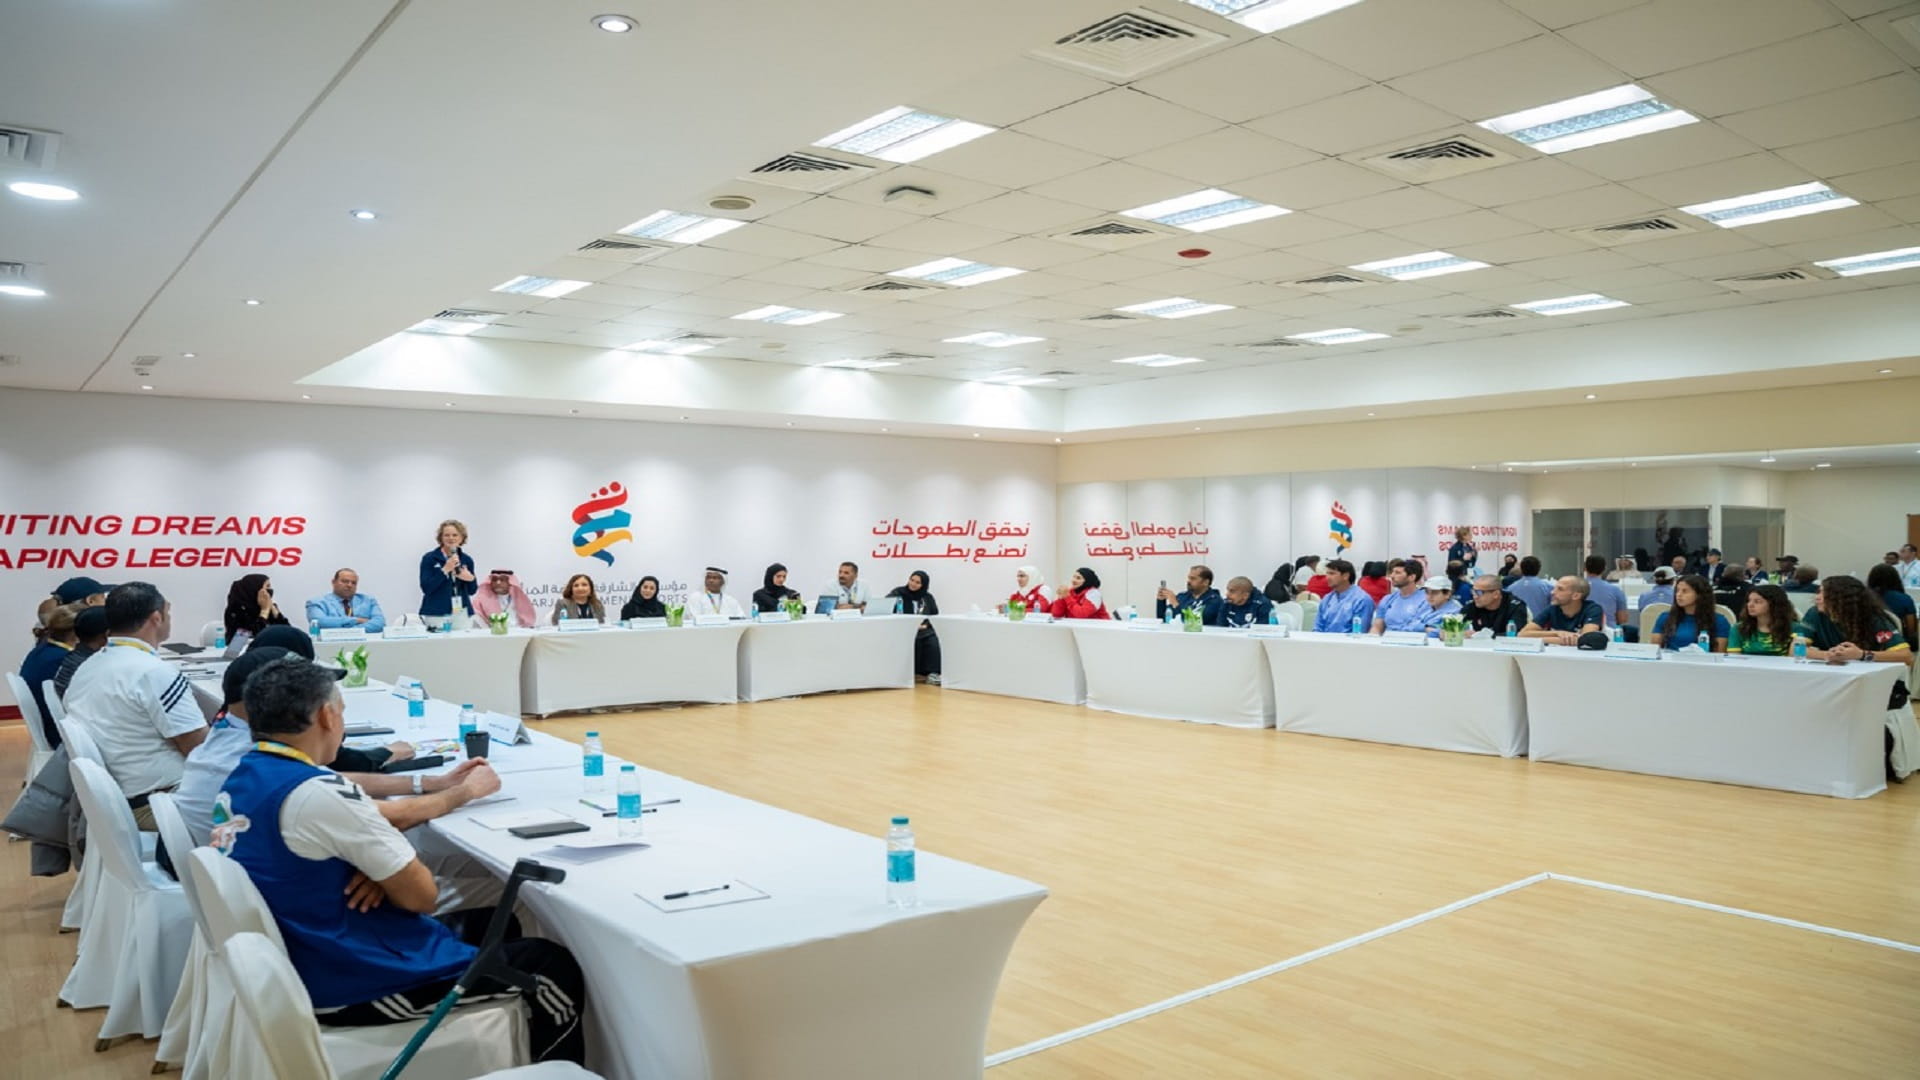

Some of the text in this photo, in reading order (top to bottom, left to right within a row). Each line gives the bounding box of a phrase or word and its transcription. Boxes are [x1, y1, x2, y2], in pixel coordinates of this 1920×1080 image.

[0, 514, 306, 536] ITING DREAMS
[872, 519, 1030, 541] نحقق الطموحات
[125, 547, 302, 567] LEGENDS
